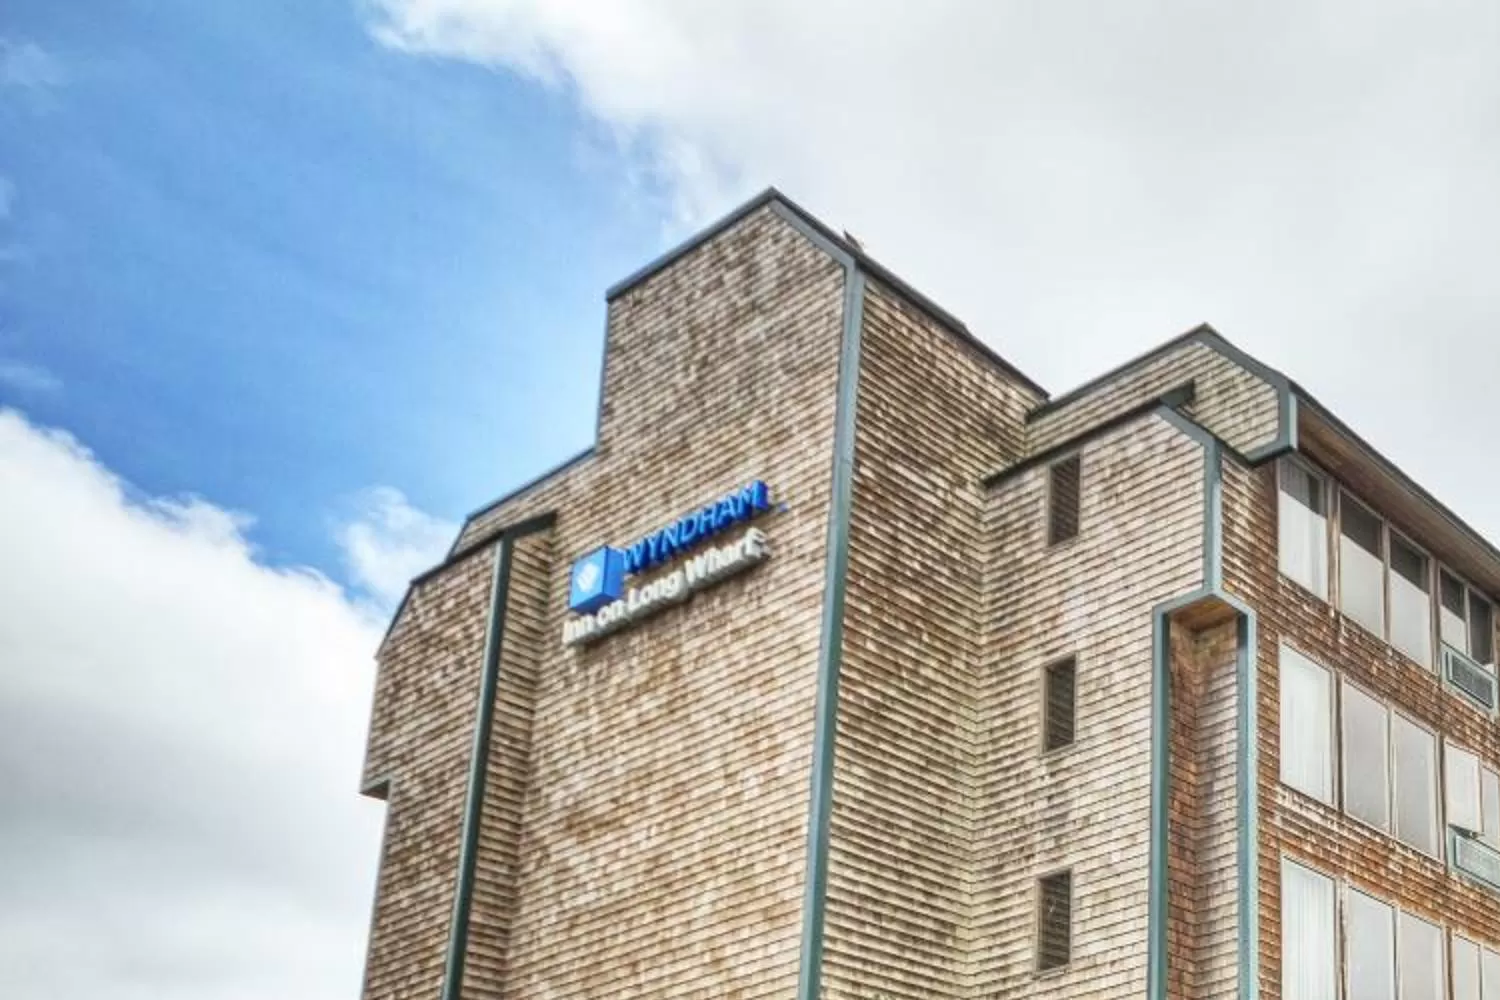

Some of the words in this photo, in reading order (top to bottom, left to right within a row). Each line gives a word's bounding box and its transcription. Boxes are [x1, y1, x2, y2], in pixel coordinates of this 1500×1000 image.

[623, 480, 769, 573] WYNDHAM
[562, 612, 597, 645] Inn
[596, 600, 627, 626] on
[627, 567, 688, 612] Long
[684, 526, 770, 585] Wharf
